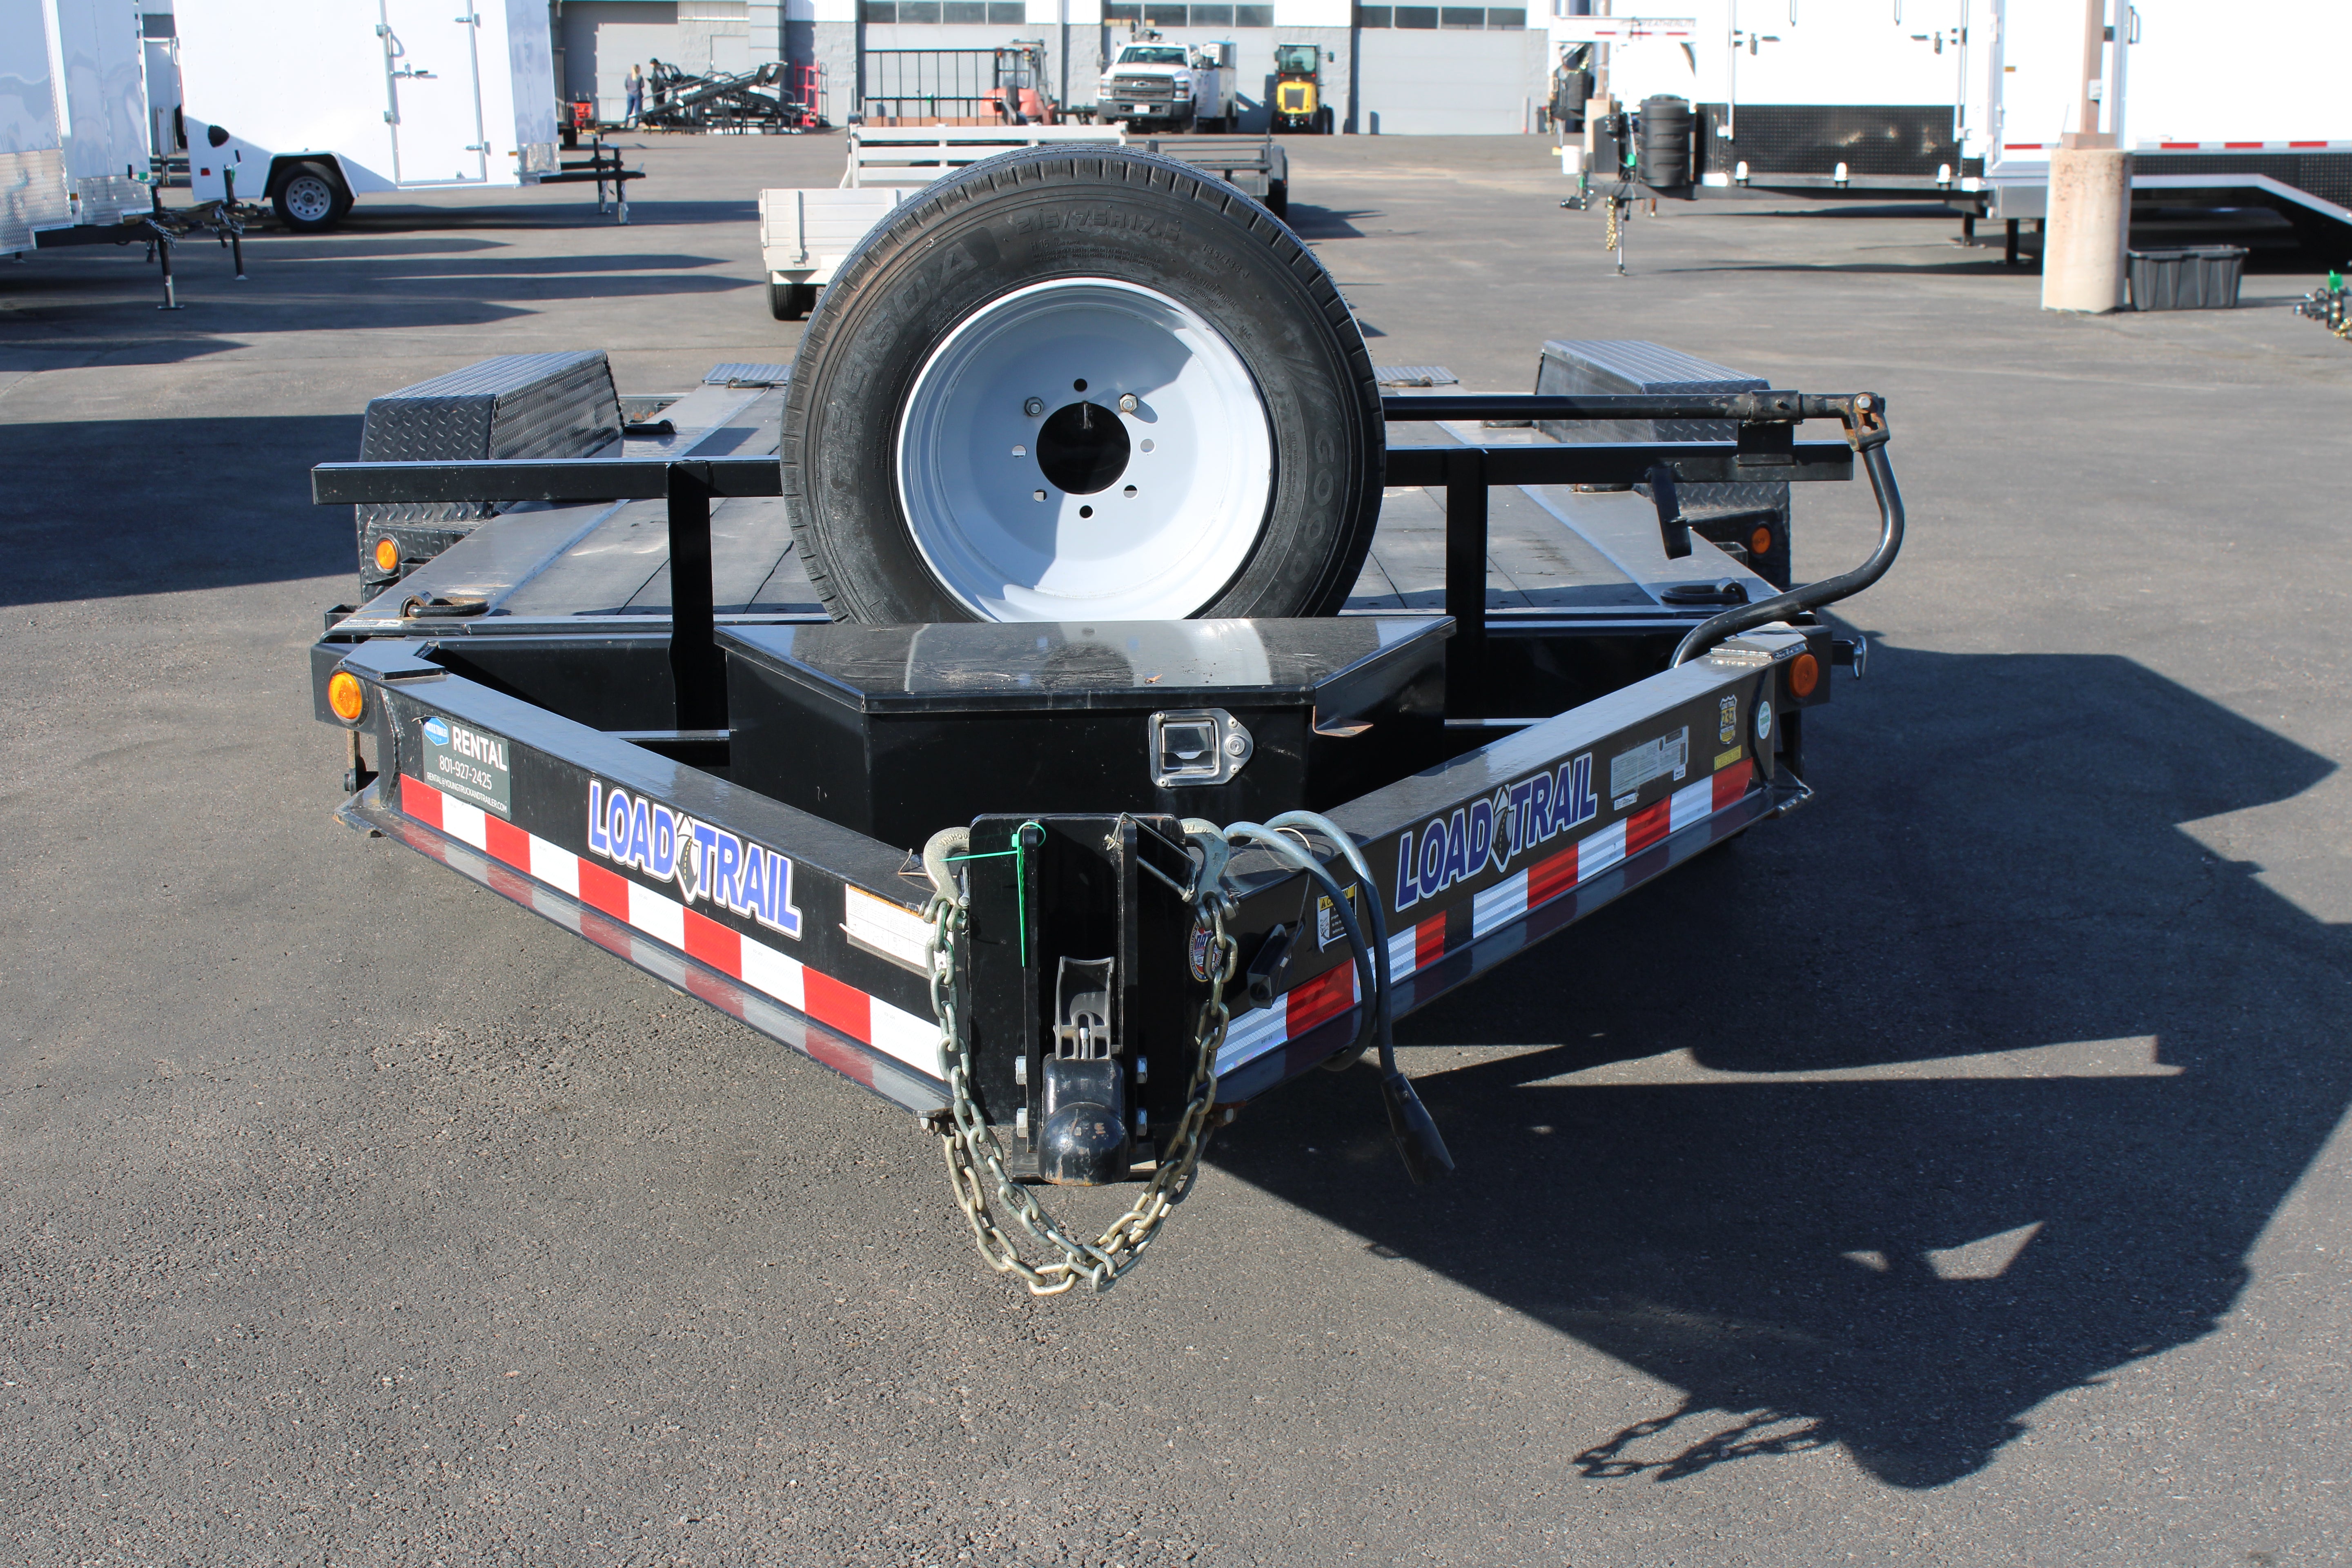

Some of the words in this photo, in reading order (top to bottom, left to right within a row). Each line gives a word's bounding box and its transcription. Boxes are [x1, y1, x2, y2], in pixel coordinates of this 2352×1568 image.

[1016, 209, 1181, 242] 215/75R17.5
[1039, 239, 1049, 248] 16
[1202, 244, 1242, 273] 135/133
[1185, 270, 1196, 281] ALL
[1197, 277, 1216, 292] STEEL
[1216, 290, 1237, 308] RADIAL
[1189, 285, 1221, 309] REGROOVABLE
[932, 303, 954, 322] TUBELESS
[452, 725, 508, 772] RENTAL
[439, 754, 492, 790] 801-927-2425
[427, 772, 507, 813] RENTAL@YOUNGTRUCKANDTRAILER.COM
[1395, 797, 1494, 912] LOAD
[1509, 752, 1597, 856] TRAIL
[588, 778, 677, 883] LOAD
[693, 818, 803, 941] TRAIL
